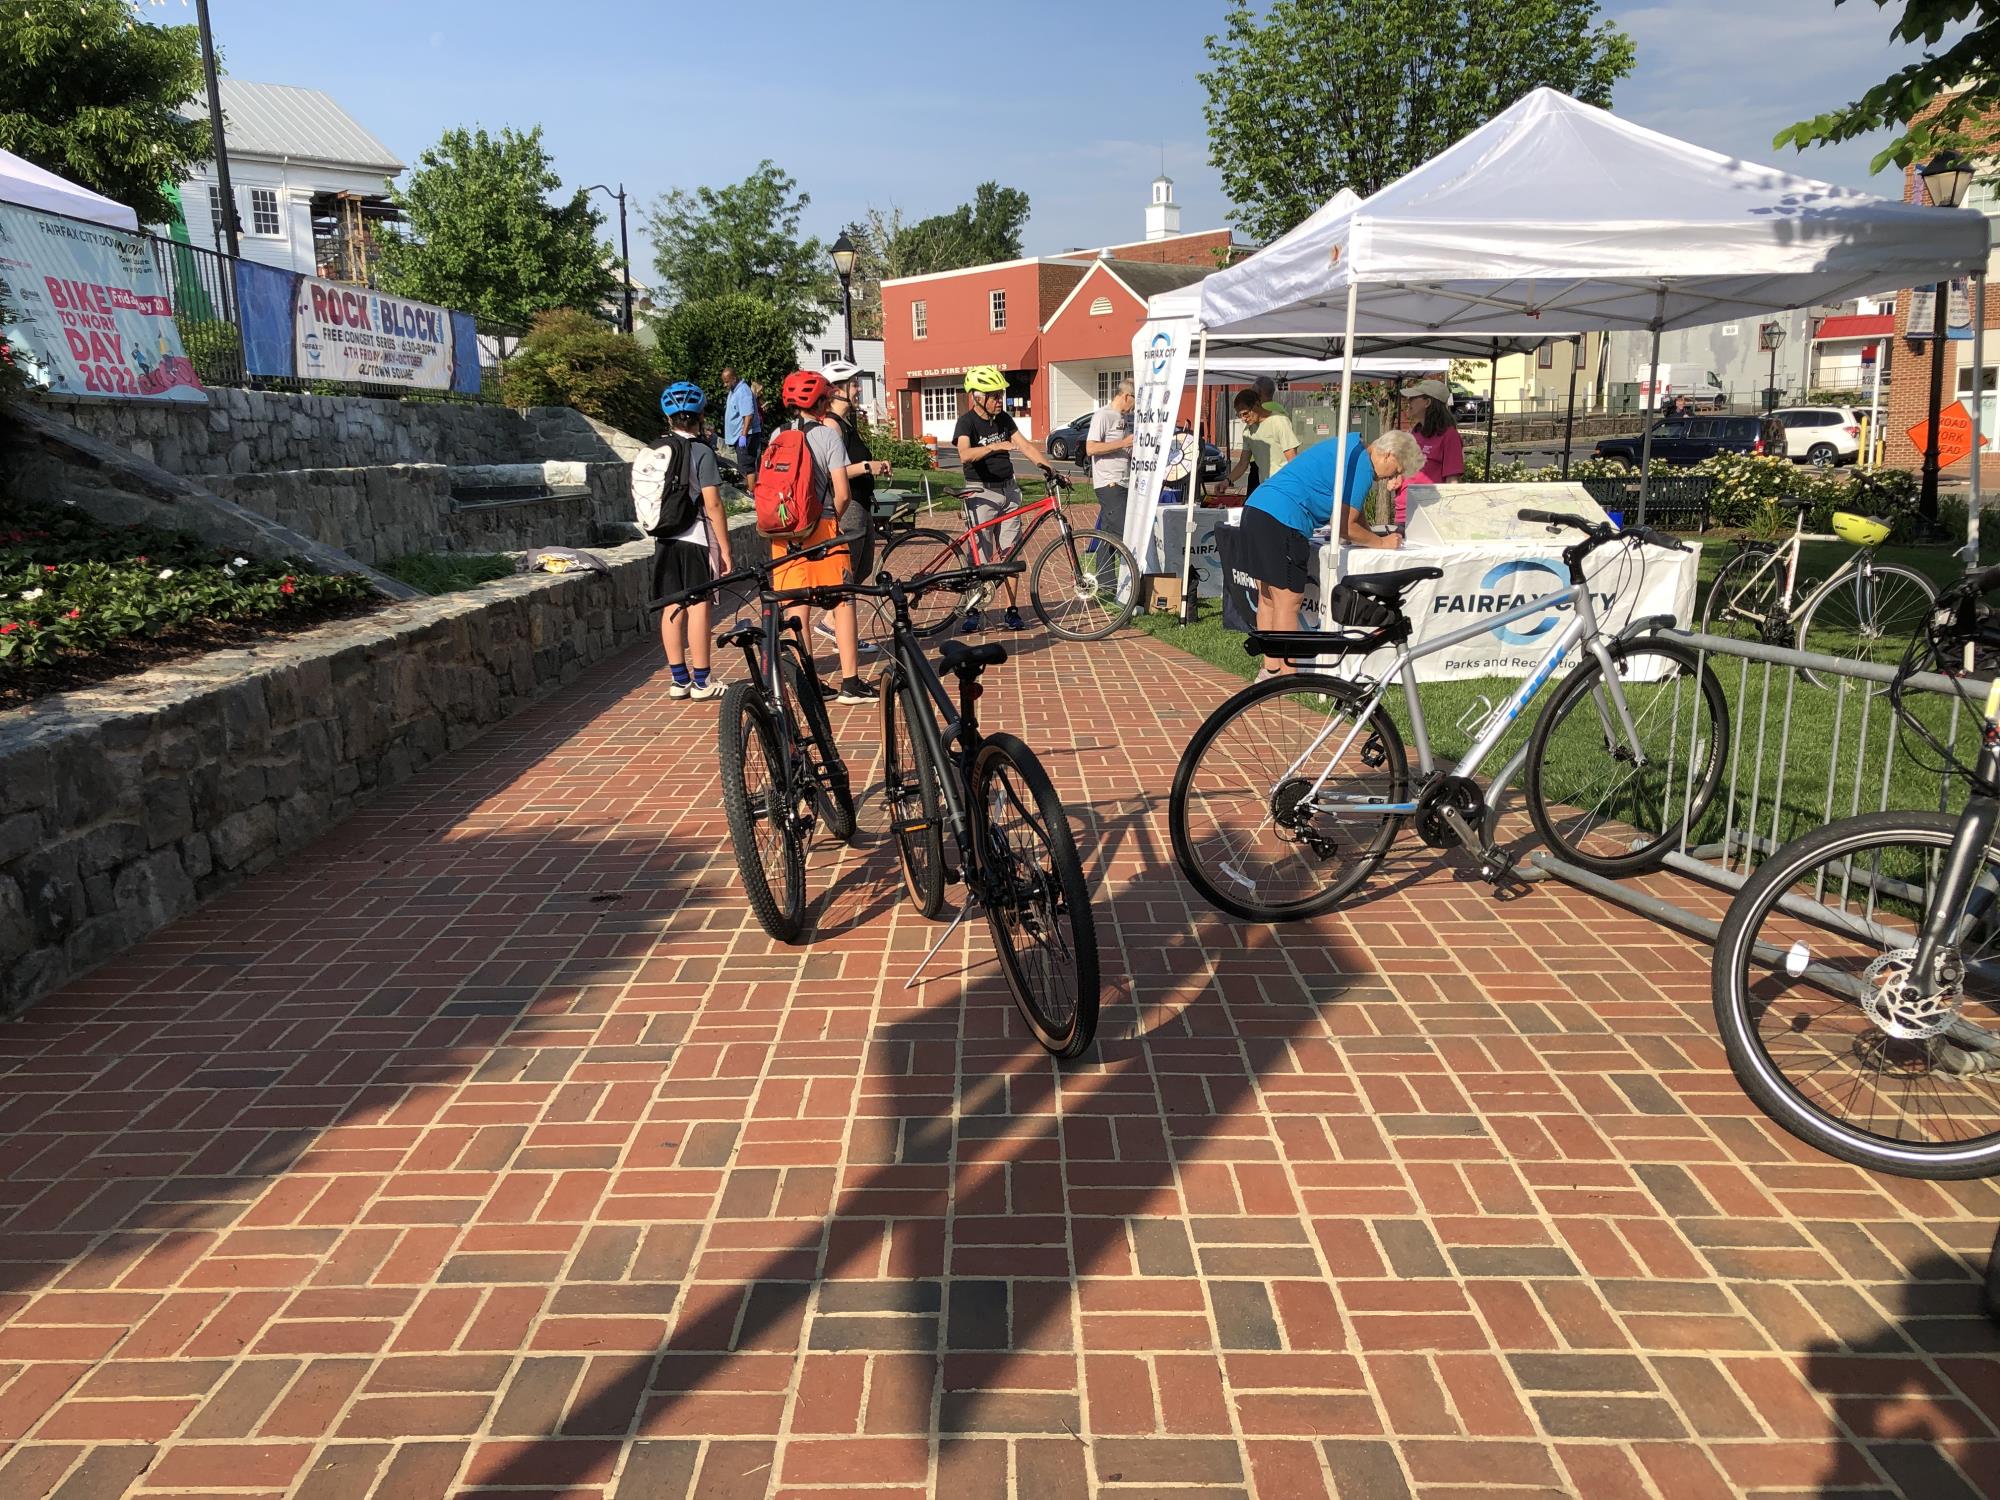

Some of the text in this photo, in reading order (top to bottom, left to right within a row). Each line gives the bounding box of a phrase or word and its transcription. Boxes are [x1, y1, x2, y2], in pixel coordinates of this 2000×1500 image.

[39, 221, 80, 241] FAIRFAX
[80, 230, 99, 245] CITY
[44, 275, 113, 315] BIKE
[111, 290, 138, 307] Frida
[138, 300, 151, 314] ay
[58, 310, 119, 333] TO WORK
[310, 283, 372, 331] ROCK
[379, 299, 440, 344] BLOCK
[64, 327, 126, 365] DAY
[322, 327, 344, 342] FREE
[344, 332, 375, 346] CONCERT
[375, 335, 396, 351] SERIES
[343, 345, 359, 360] 4TH
[1144, 348, 1165, 360] FAIRAX
[79, 363, 139, 394] 2022
[370, 365, 391, 379] TOWN
[391, 367, 415, 380] SQUARE
[924, 368, 940, 376] OLD
[941, 367, 961, 375] FIRE
[1157, 408, 1169, 423] Yu
[1144, 432, 1158, 448] Ou
[1939, 430, 1964, 442] ORK
[1939, 444, 1961, 455] EAD
[1182, 544, 1220, 556] FAIRFA
[1433, 592, 1616, 613] FAIRFAX TY
[1445, 656, 1581, 671] Parks and Rectio
[1505, 644, 1567, 721] TREK
[1705, 720, 1719, 783] BONTRAGER
